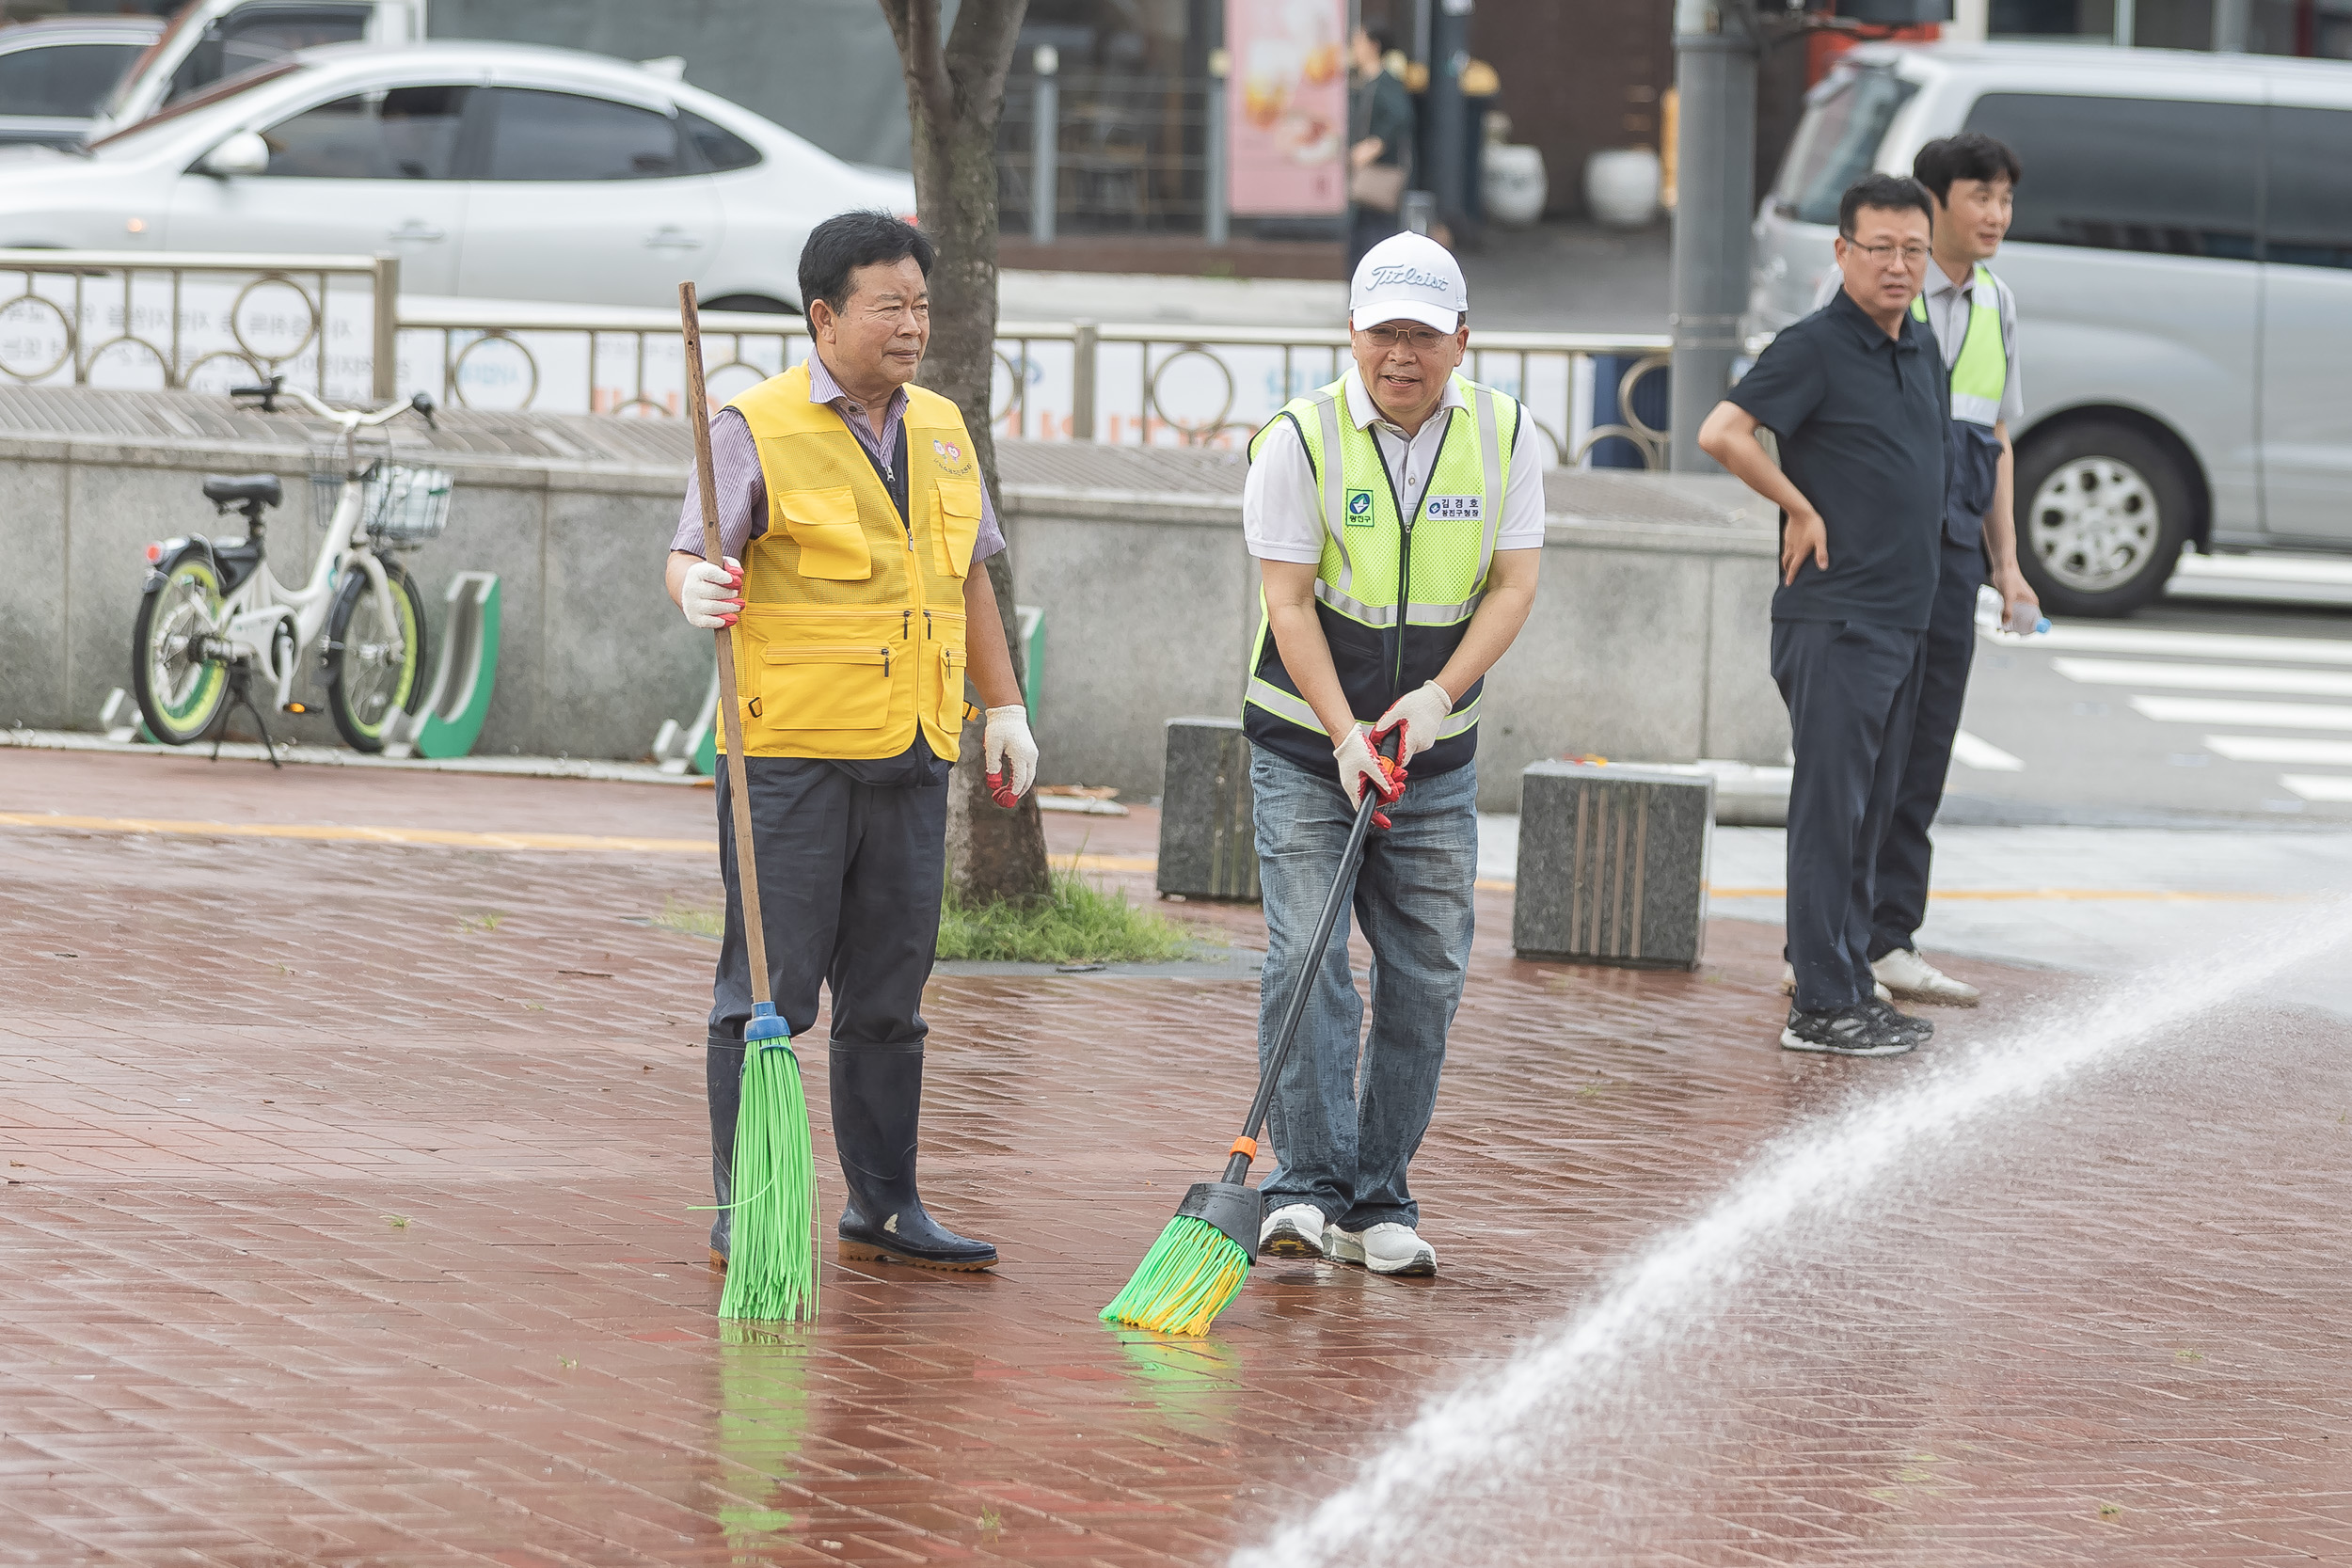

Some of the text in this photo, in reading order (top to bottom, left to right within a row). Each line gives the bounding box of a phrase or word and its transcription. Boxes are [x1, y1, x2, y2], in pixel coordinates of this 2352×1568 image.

[1365, 264, 1449, 291] Titleist
[1441, 509, 1479, 517] 광진구청장
[1349, 515, 1371, 523] 광진구
